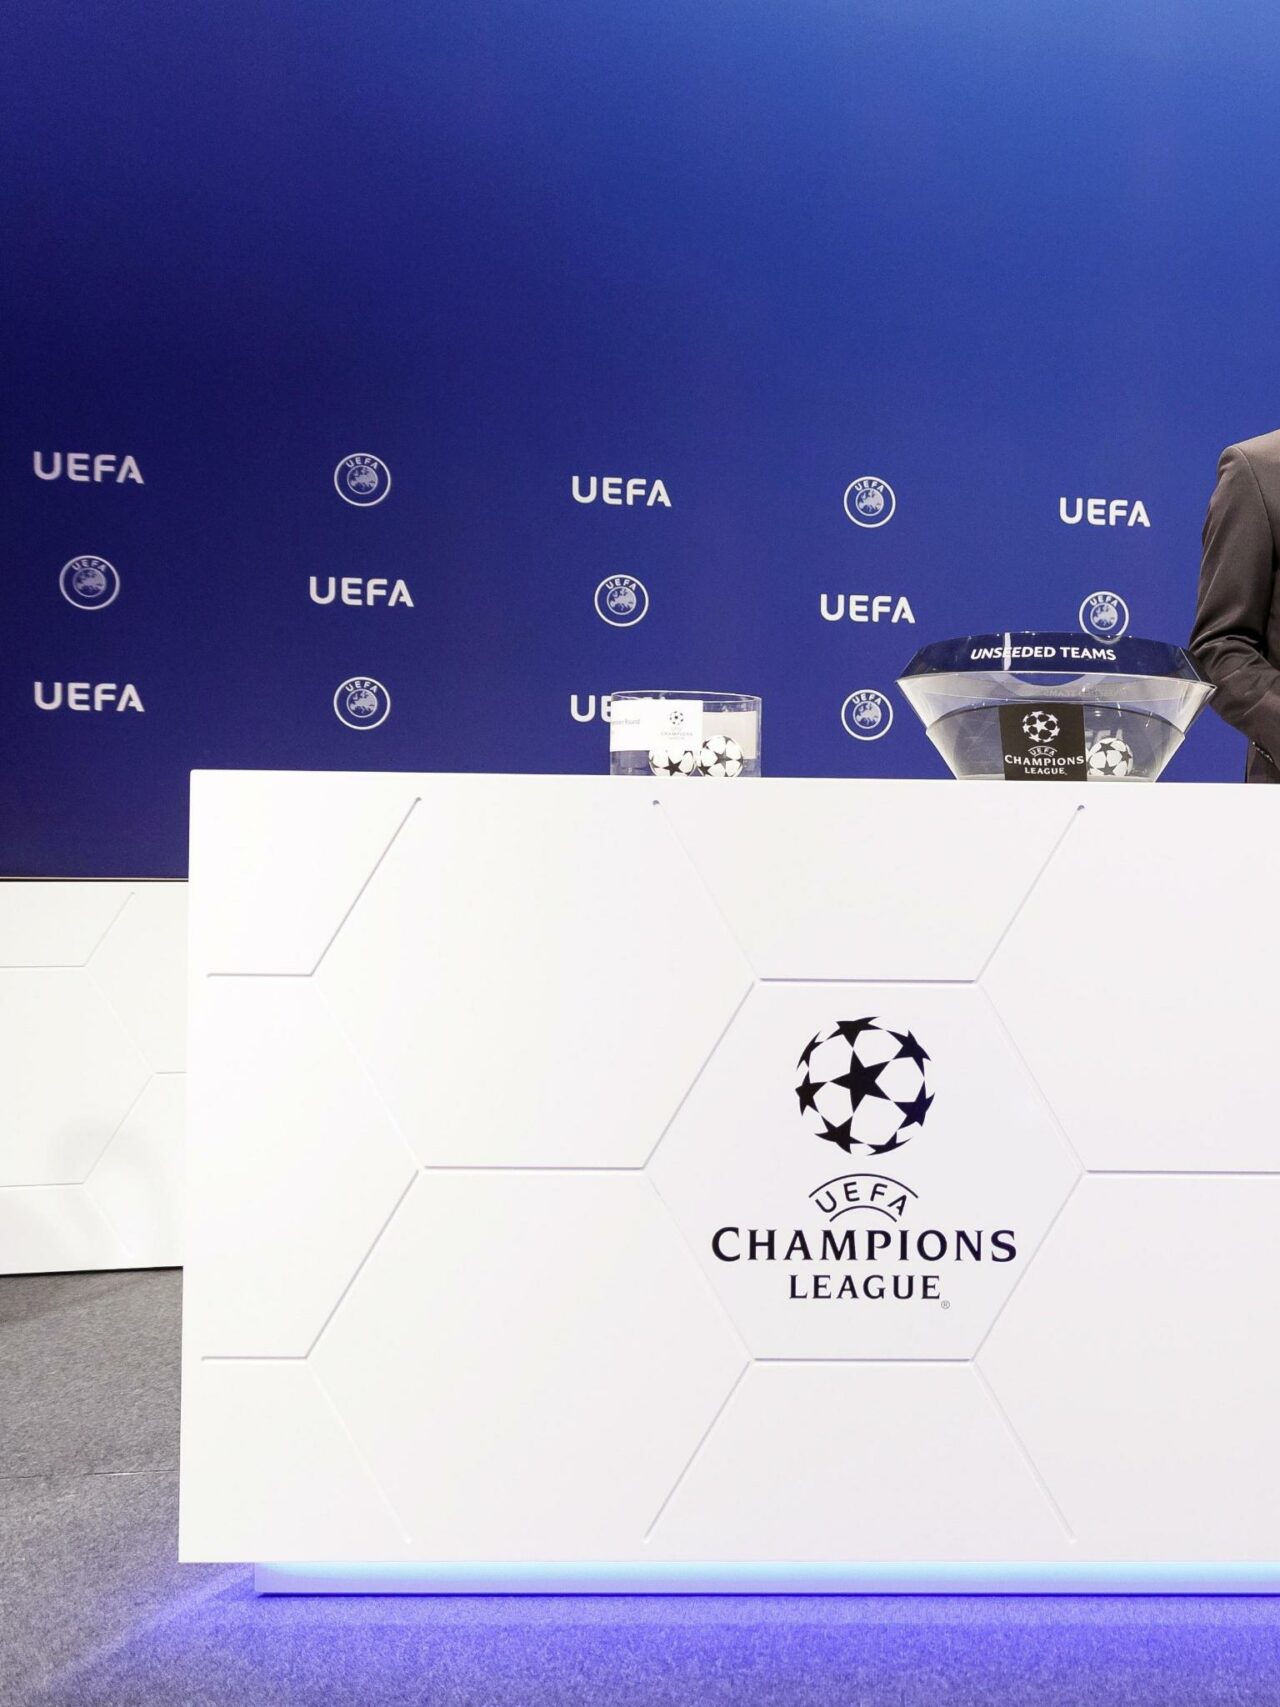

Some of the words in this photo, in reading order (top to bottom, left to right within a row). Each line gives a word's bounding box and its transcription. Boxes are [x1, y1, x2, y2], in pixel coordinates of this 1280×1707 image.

[34, 451, 145, 484] UEFA
[572, 475, 672, 507] UEFA
[1060, 497, 1151, 528] UEFA
[309, 577, 415, 607] UEFA
[820, 594, 915, 623] UEFA
[970, 647, 1056, 660] UNSEEDED
[1060, 647, 1116, 660] TEAMS
[34, 682, 145, 712] UEFA
[1004, 754, 1085, 766] CHAMPIONS
[1029, 746, 1055, 756] UEFA
[1024, 767, 1065, 775] LEAGUE
[815, 1181, 908, 1216] UEFA
[711, 1226, 1017, 1263] CHAMPIONS
[789, 1274, 941, 1300] LEAGUE
